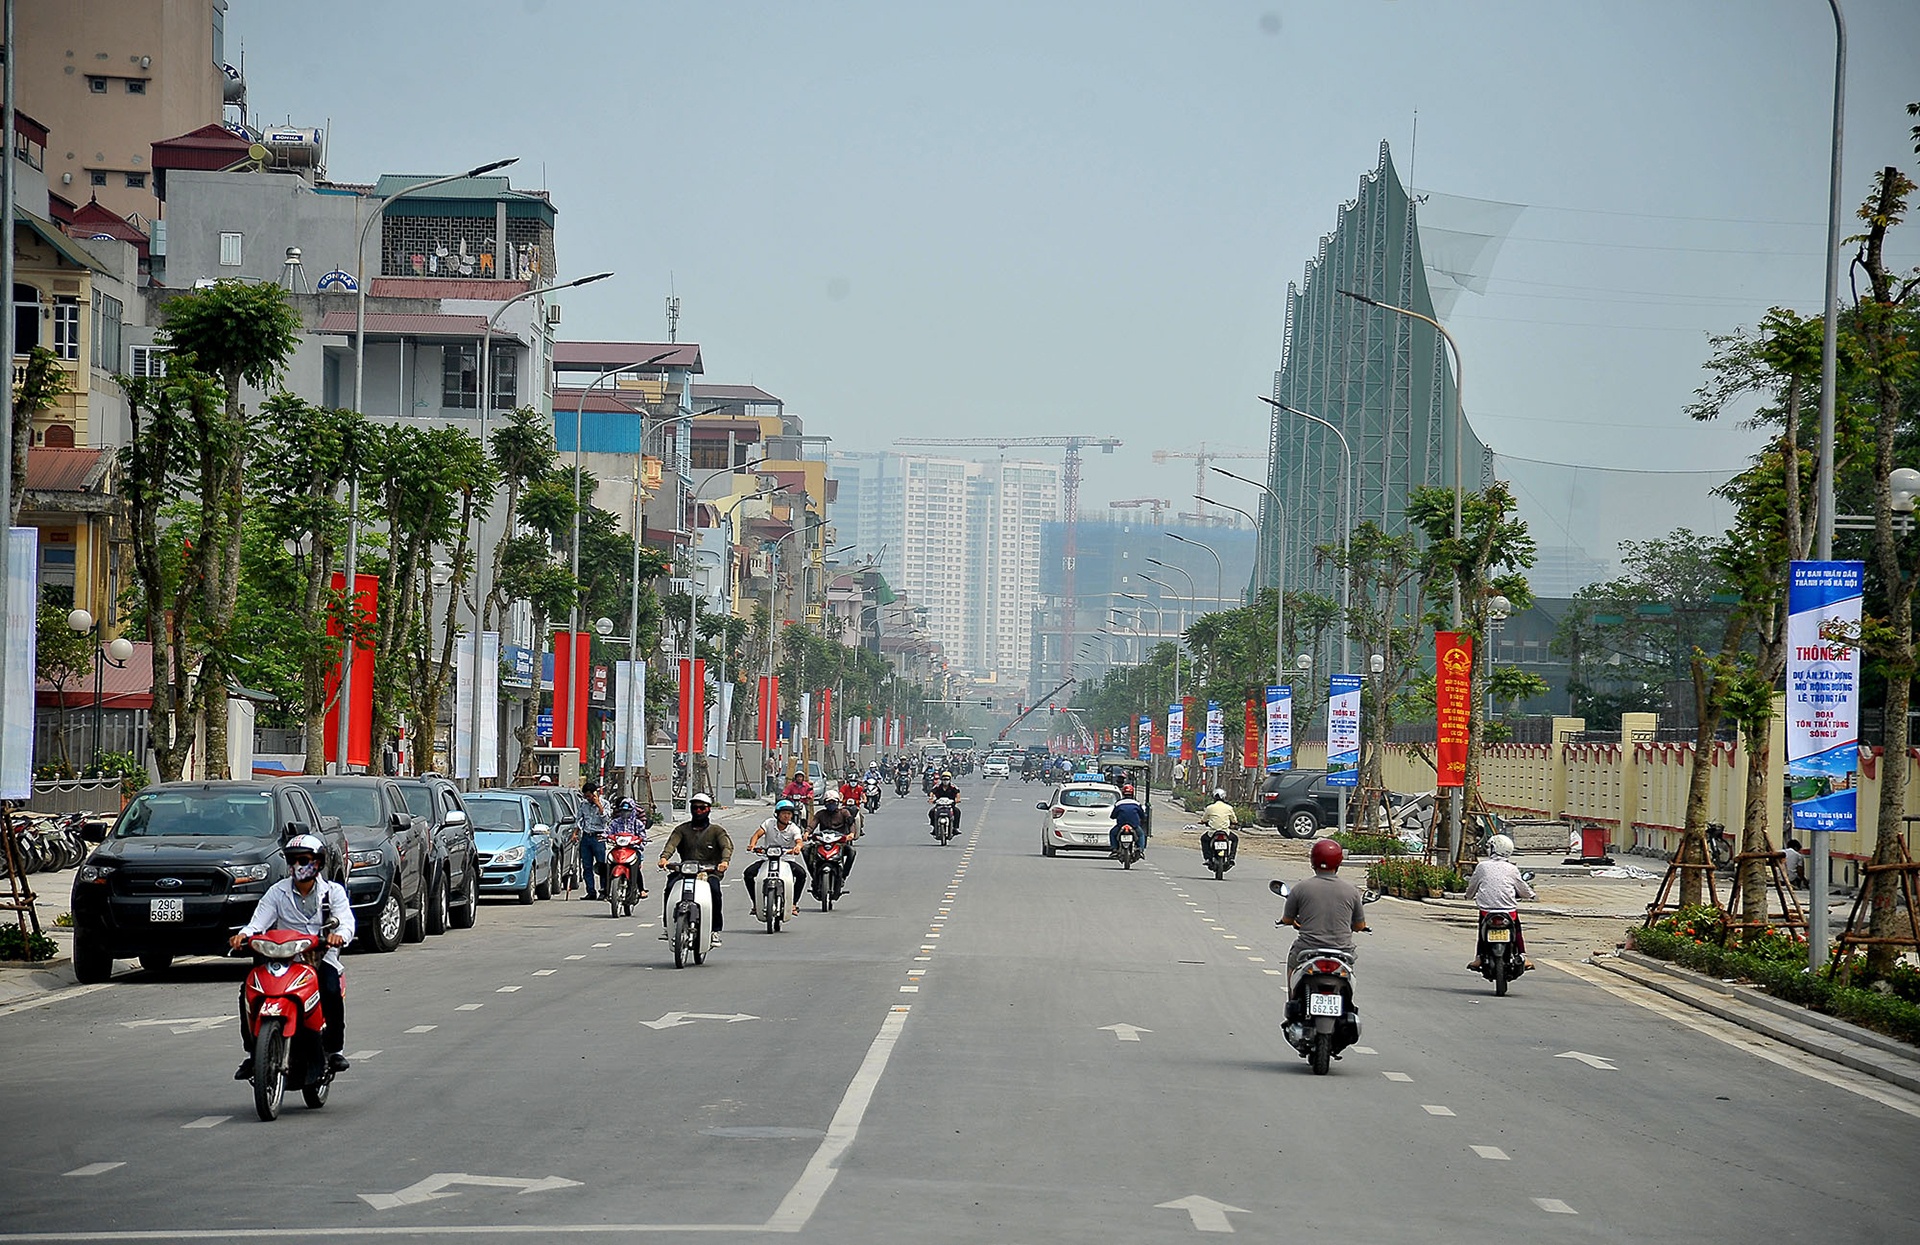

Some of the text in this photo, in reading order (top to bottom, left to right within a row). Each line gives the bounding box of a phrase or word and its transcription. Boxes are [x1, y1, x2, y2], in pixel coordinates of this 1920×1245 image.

[1807, 570, 1822, 578] BAN
[1795, 644, 1834, 661] THÔNG
[158, 899, 176, 910] 29C
[151, 910, 183, 921] 595.83
[1315, 995, 1336, 1005] 29-H1
[1312, 1004, 1340, 1015] 662.55
